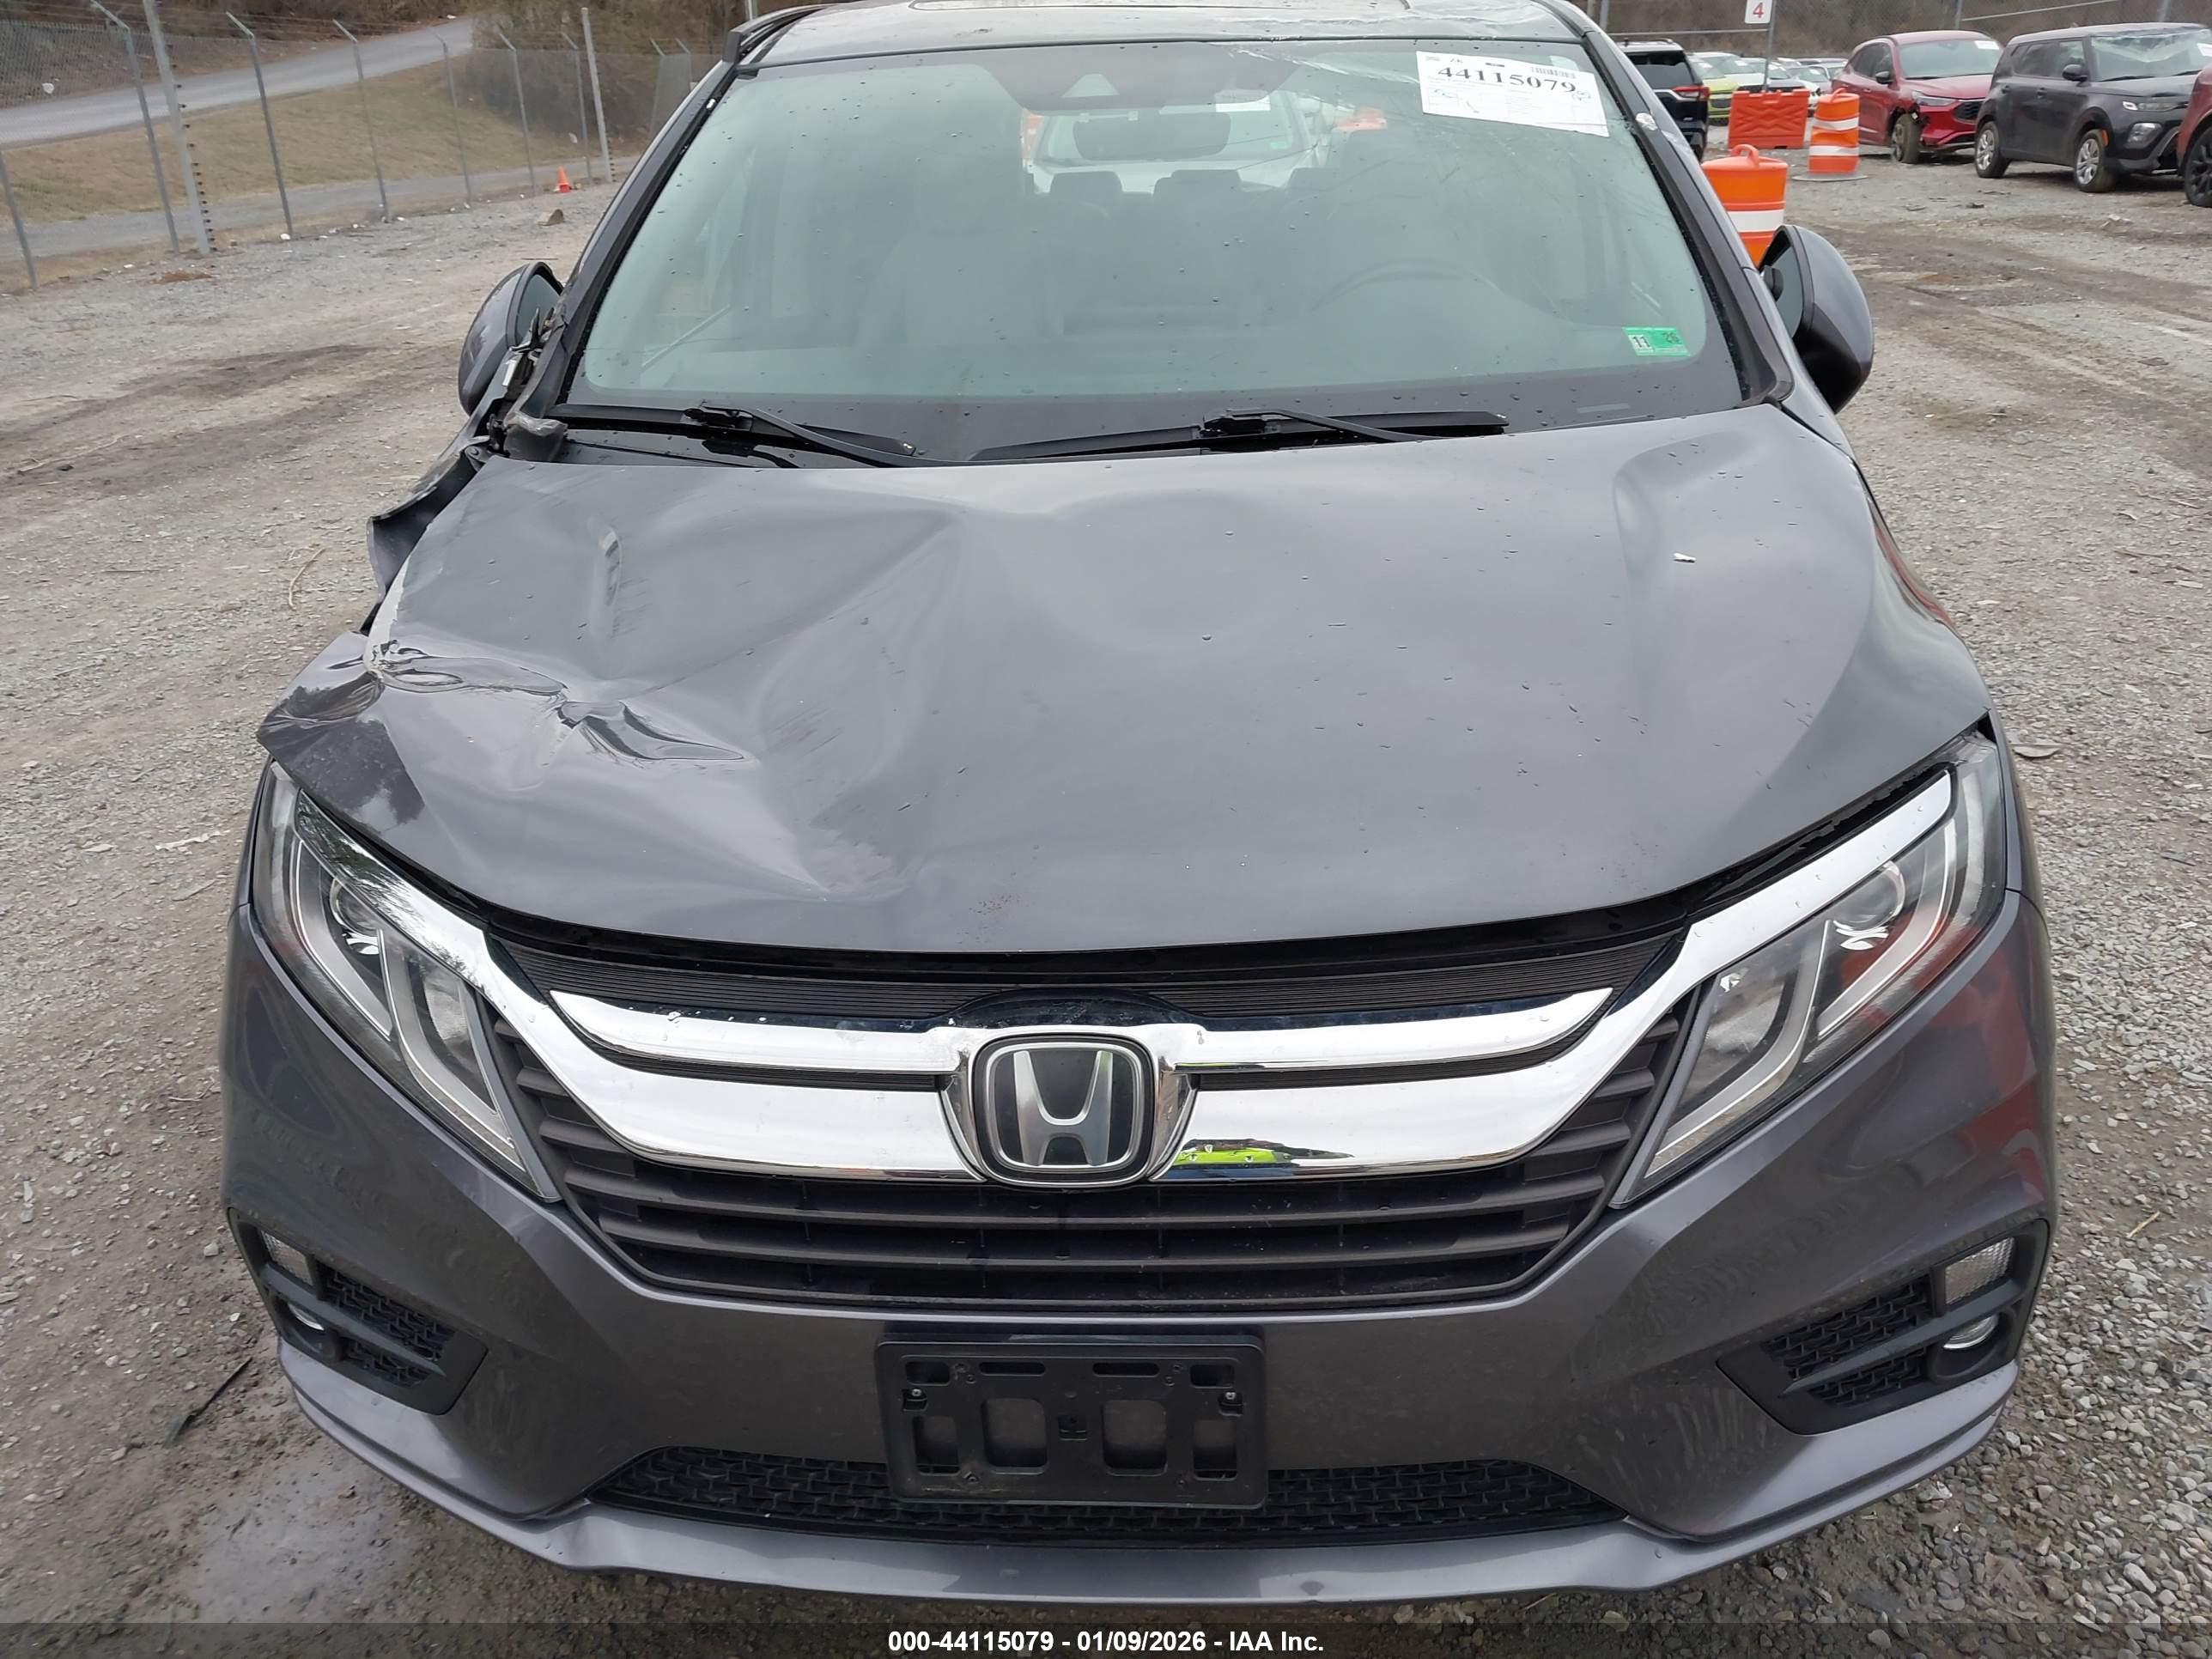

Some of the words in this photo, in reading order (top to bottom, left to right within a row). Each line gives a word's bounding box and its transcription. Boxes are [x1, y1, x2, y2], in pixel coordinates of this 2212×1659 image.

[1753, 2, 1765, 18] 4
[1437, 66, 1577, 94] 44115079
[1632, 336, 1650, 348] 11
